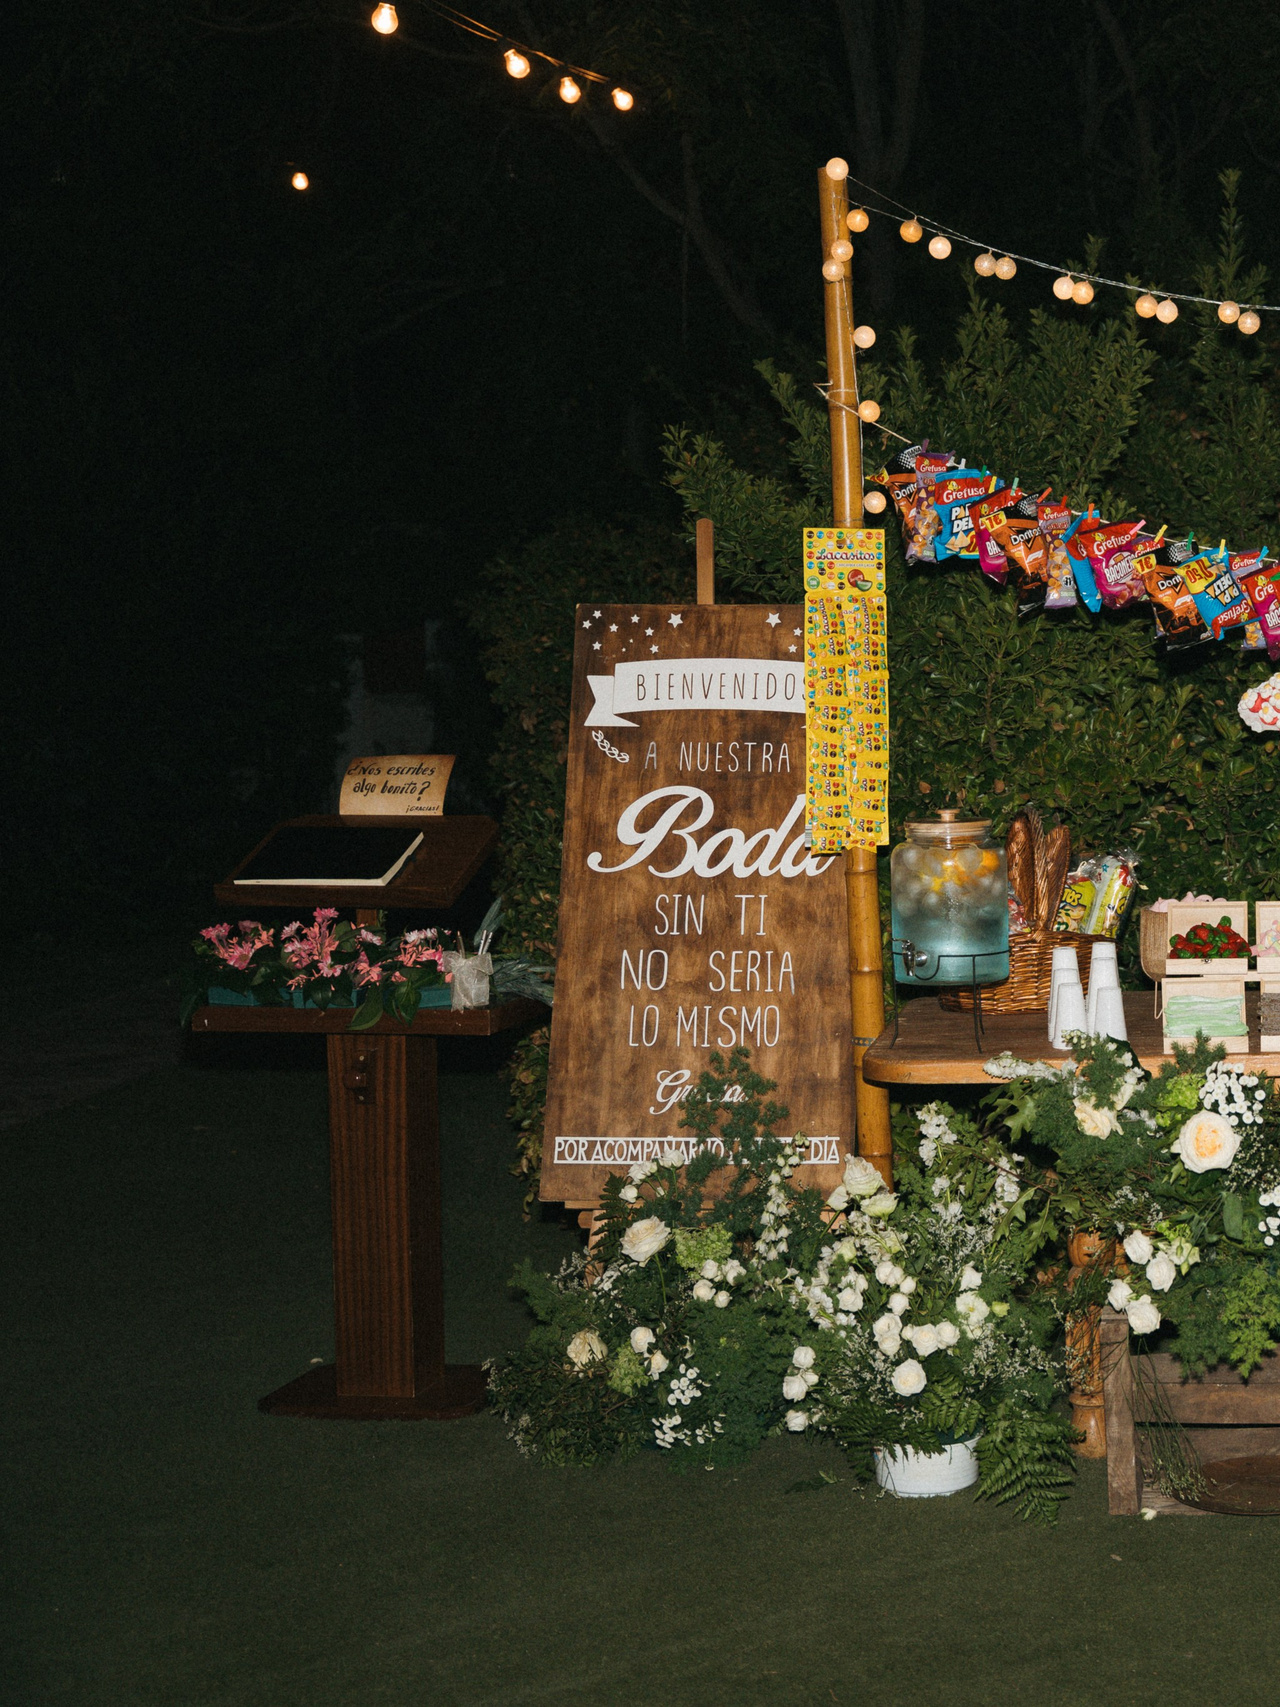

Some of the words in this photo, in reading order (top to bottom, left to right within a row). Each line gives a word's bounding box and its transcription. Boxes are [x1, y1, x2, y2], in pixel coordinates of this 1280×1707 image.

[920, 464, 947, 472] Grefusa
[893, 482, 917, 500] Dorit
[943, 486, 985, 503] Grefusa
[1043, 510, 1069, 520] Grefusa
[1010, 526, 1042, 546] Doritos
[1093, 533, 1131, 555] Grefusa
[815, 548, 875, 560] Lacasitos
[1137, 556, 1153, 572] 1€
[819, 598, 830, 636] Lacasitos
[859, 596, 871, 635] Lacasitos
[636, 672, 806, 701] BIENVENIDO
[645, 741, 657, 769] A
[679, 741, 790, 773] NUESTRA
[347, 761, 382, 776] ¿Nos
[386, 762, 437, 776] escribes
[352, 778, 376, 797] algo
[380, 780, 431, 801] bonito?
[654, 893, 705, 936] SIN
[735, 894, 768, 936] TI
[620, 949, 669, 991] NO
[708, 950, 795, 995] SERIA
[628, 1005, 660, 1047] LO
[676, 1004, 780, 1048] MISMO
[554, 1139, 588, 1161] POR
[811, 1136, 840, 1162] DÍA
